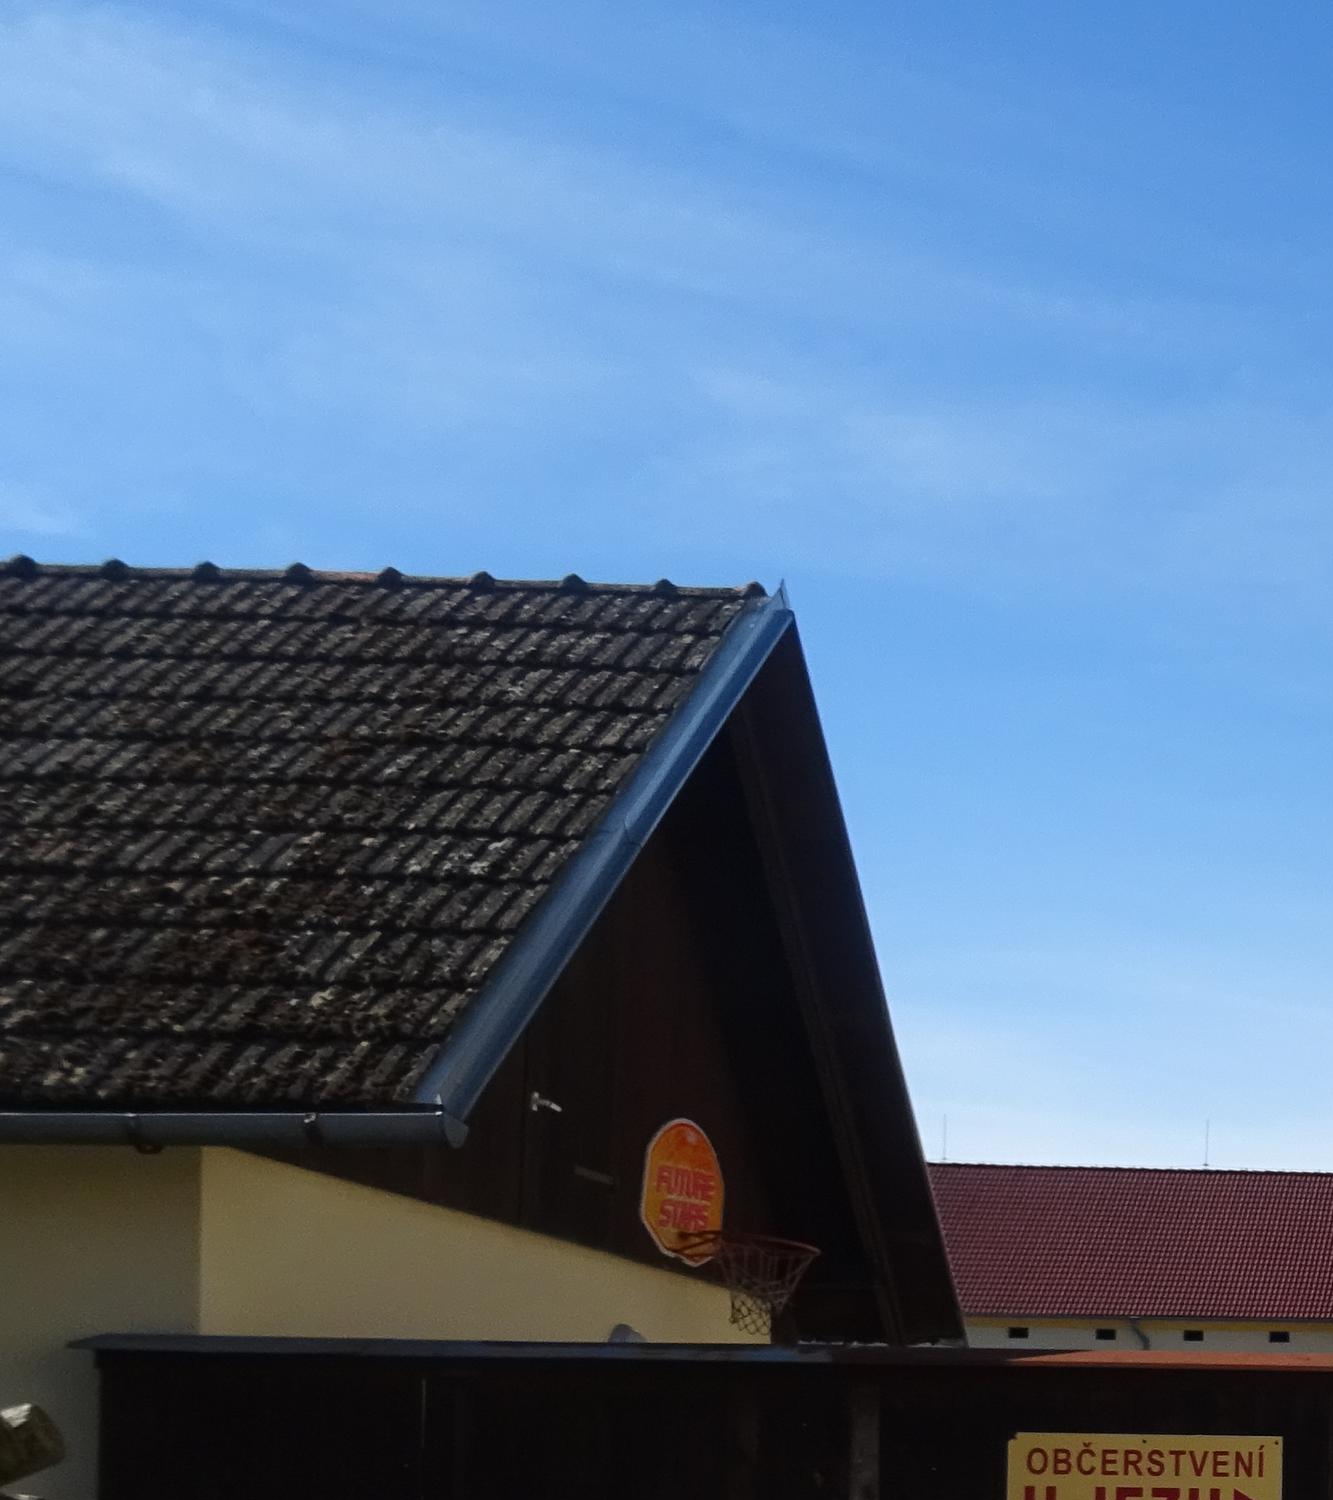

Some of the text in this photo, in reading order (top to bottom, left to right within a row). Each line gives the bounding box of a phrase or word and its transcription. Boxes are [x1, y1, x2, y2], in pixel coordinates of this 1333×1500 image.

[656, 1165, 715, 1200] FUTURE
[658, 1200, 710, 1231] STARS
[1026, 1442, 1265, 1478] OBČERSTVENÍ
